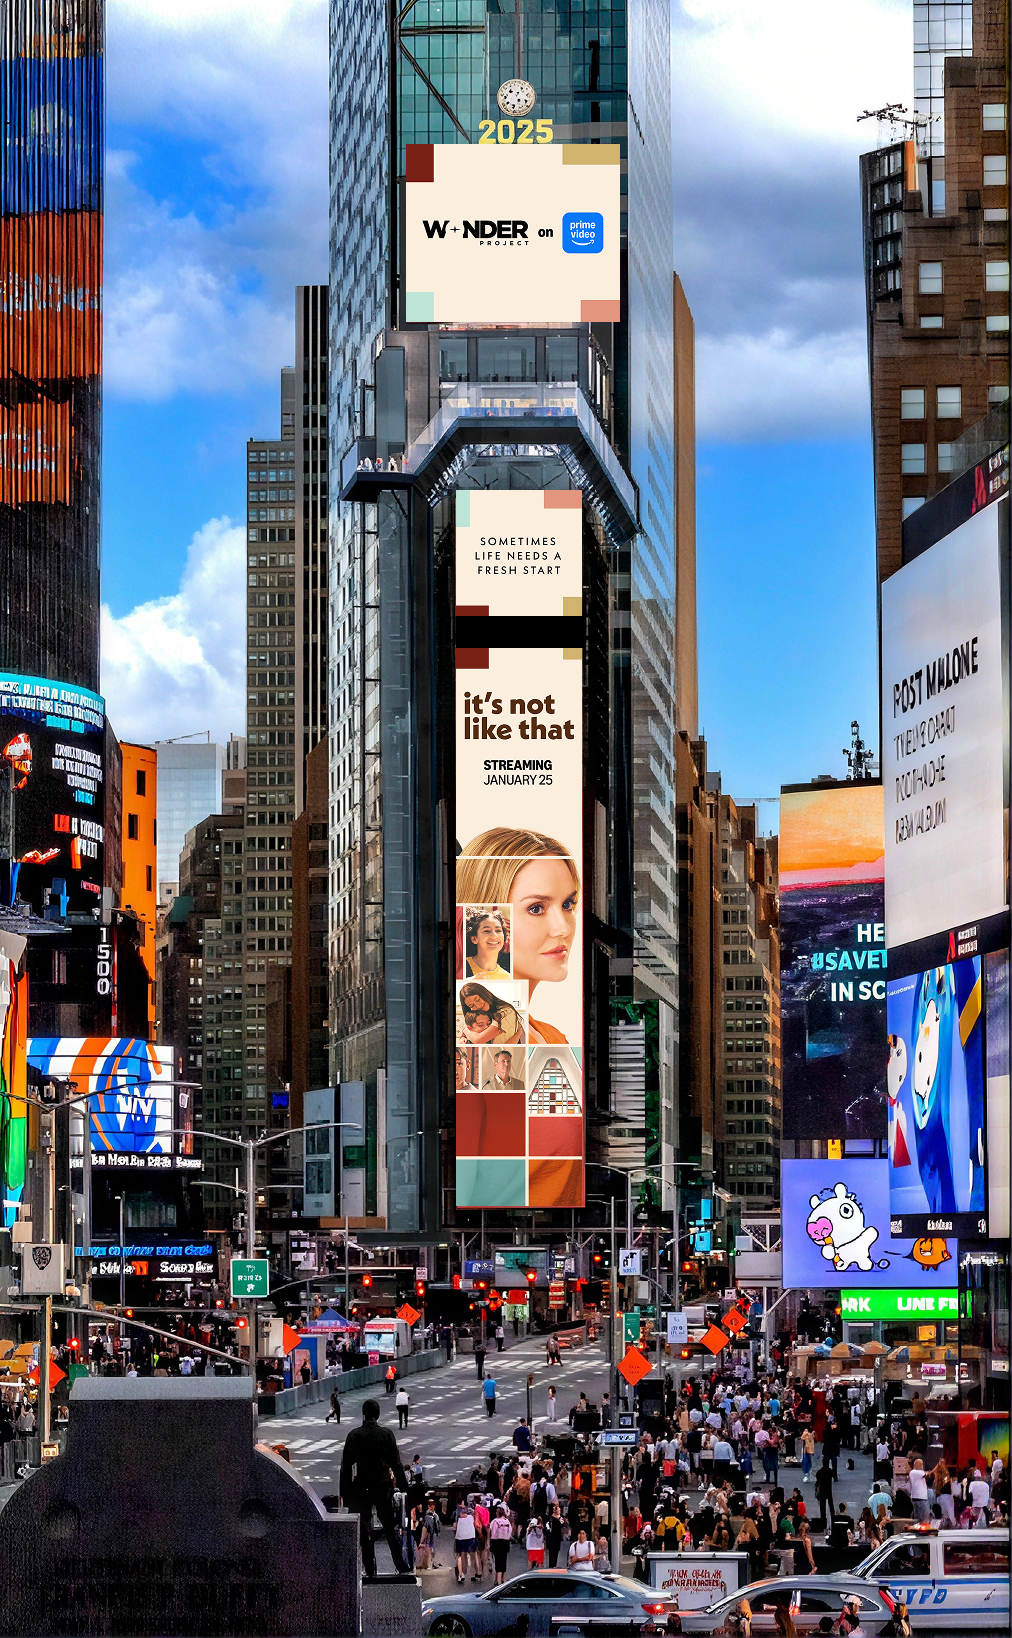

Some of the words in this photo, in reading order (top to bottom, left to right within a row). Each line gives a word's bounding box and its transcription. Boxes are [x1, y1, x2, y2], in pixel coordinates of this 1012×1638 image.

[477, 118, 554, 144] 2025
[570, 220, 595, 230] prime
[538, 229, 553, 237] on
[571, 230, 595, 238] video
[481, 537, 555, 545] SOMETIMES
[475, 552, 500, 560] LIFE
[508, 552, 547, 560] NEEDS
[554, 552, 561, 560] A
[478, 566, 516, 574] FRESH
[523, 566, 560, 574] START
[894, 669, 923, 718] POST
[926, 637, 978, 699] MALONE
[464, 692, 502, 714] it’s
[510, 695, 555, 714] not
[465, 717, 512, 740] like
[519, 717, 574, 740] that
[484, 760, 552, 770] STREAMING
[484, 775, 537, 785] JANUARY
[539, 775, 552, 785] 25
[97, 927, 111, 995] 1500
[831, 982, 853, 1001] IN
